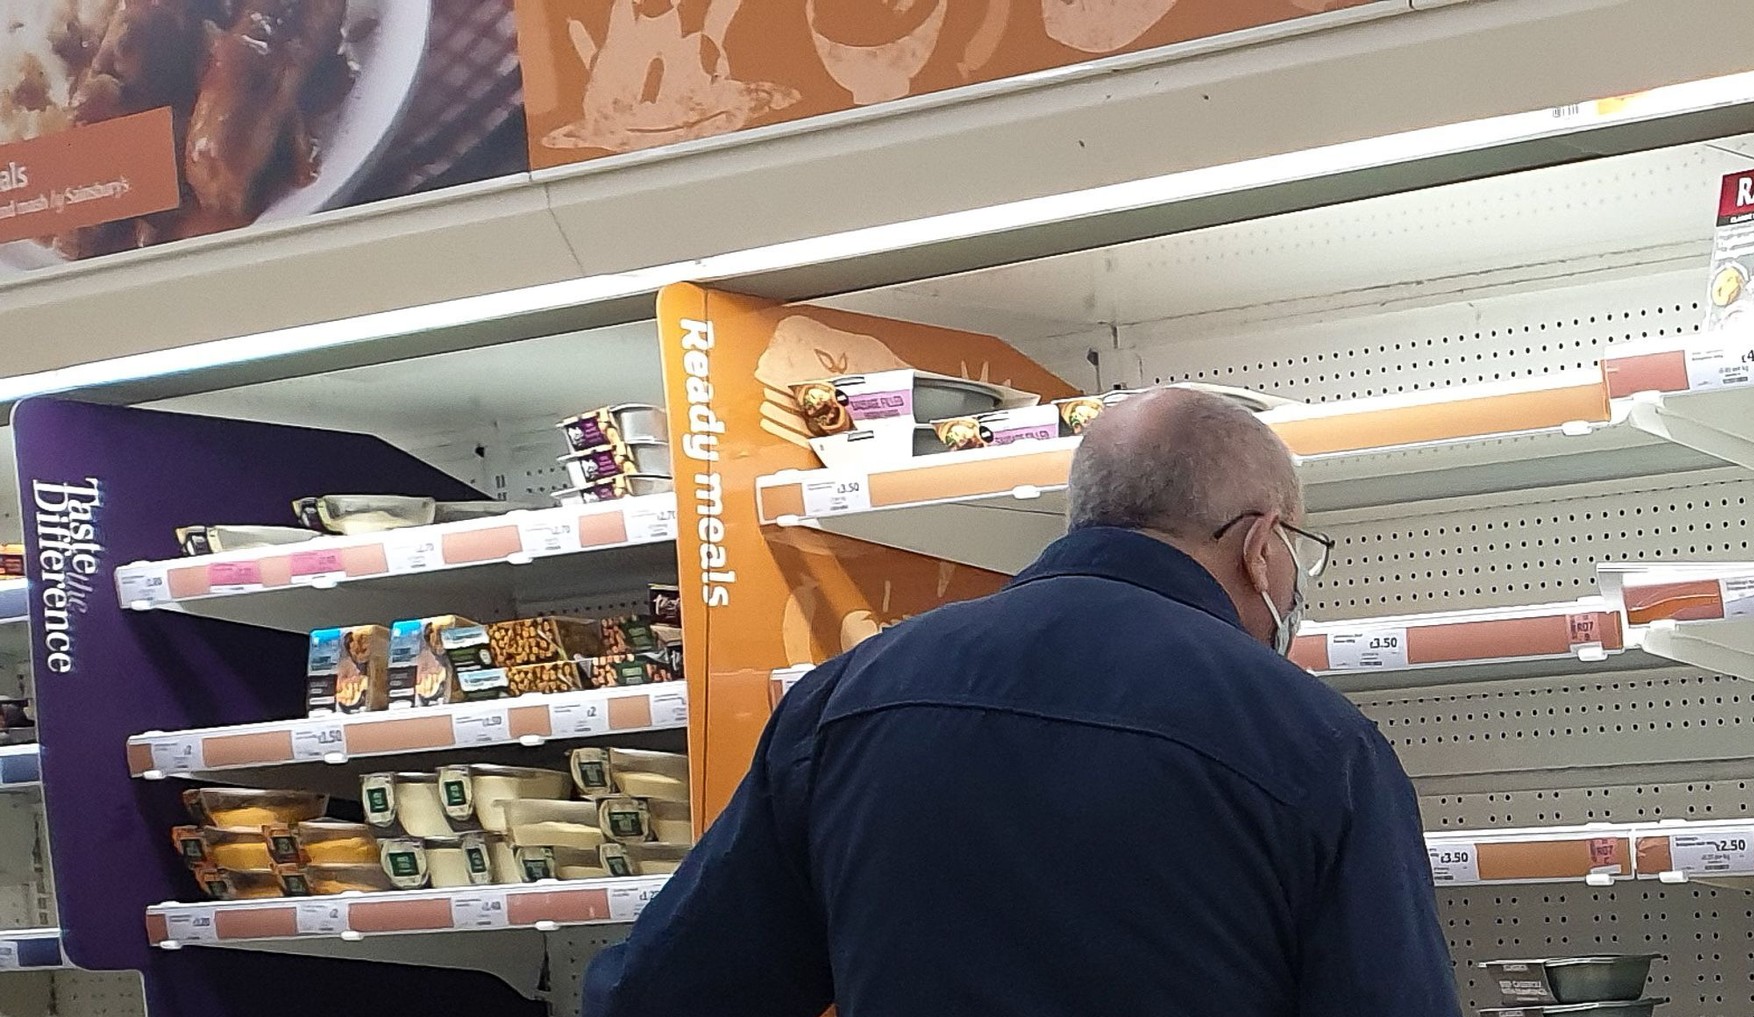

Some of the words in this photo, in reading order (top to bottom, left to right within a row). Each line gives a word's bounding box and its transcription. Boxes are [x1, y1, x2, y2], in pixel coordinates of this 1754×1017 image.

[680, 317, 727, 461] Ready
[68, 477, 106, 574] Taste
[694, 472, 737, 607] meals
[33, 479, 71, 673] Difference
[1370, 637, 1398, 649] £3.50
[1441, 852, 1469, 863] £3.50
[1715, 839, 1746, 851] £2.50
